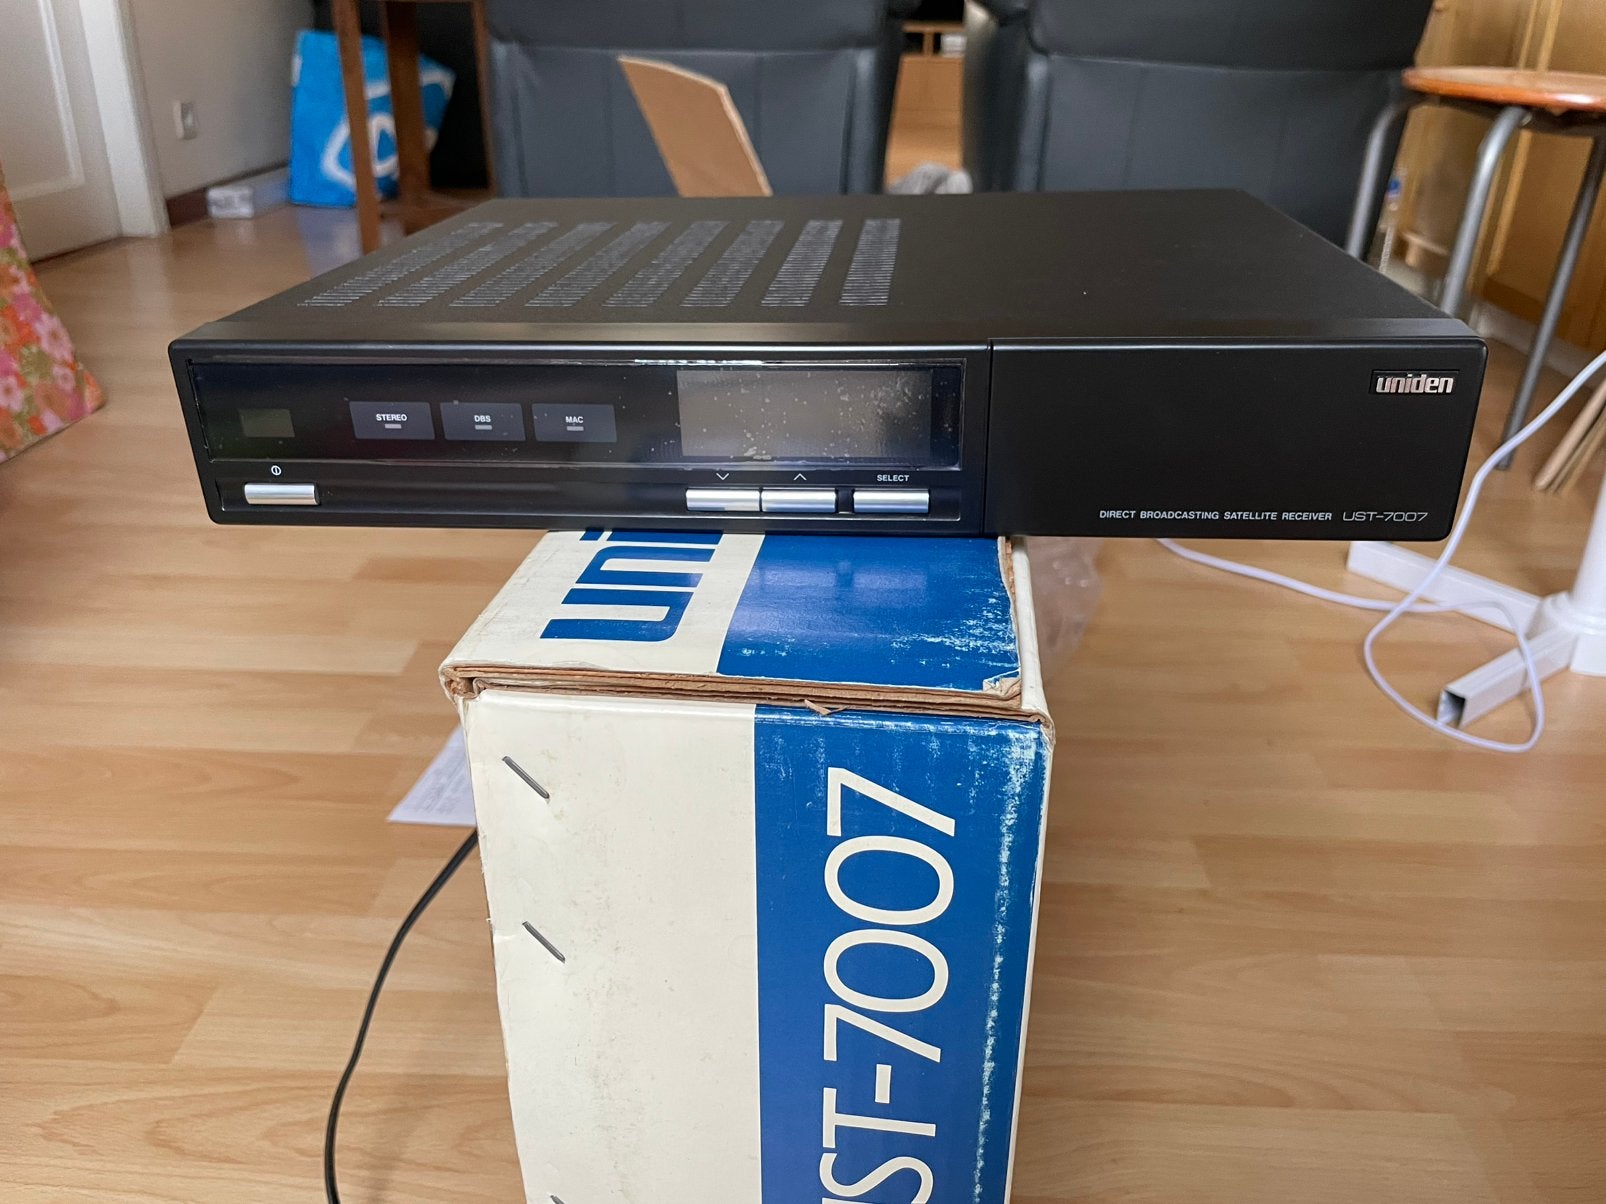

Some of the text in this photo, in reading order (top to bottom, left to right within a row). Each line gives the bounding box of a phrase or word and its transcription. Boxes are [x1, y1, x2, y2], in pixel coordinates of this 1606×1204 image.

[1375, 373, 1454, 394] uniden
[375, 413, 408, 422] STEREO
[474, 414, 491, 423] DBS
[565, 415, 584, 424] MAC
[876, 474, 910, 482] SELECT
[1099, 510, 1429, 522] DIRECT BROADCASTING SATELLITE RECEIVER UST-7007
[819, 767, 956, 1204] ST-7007
